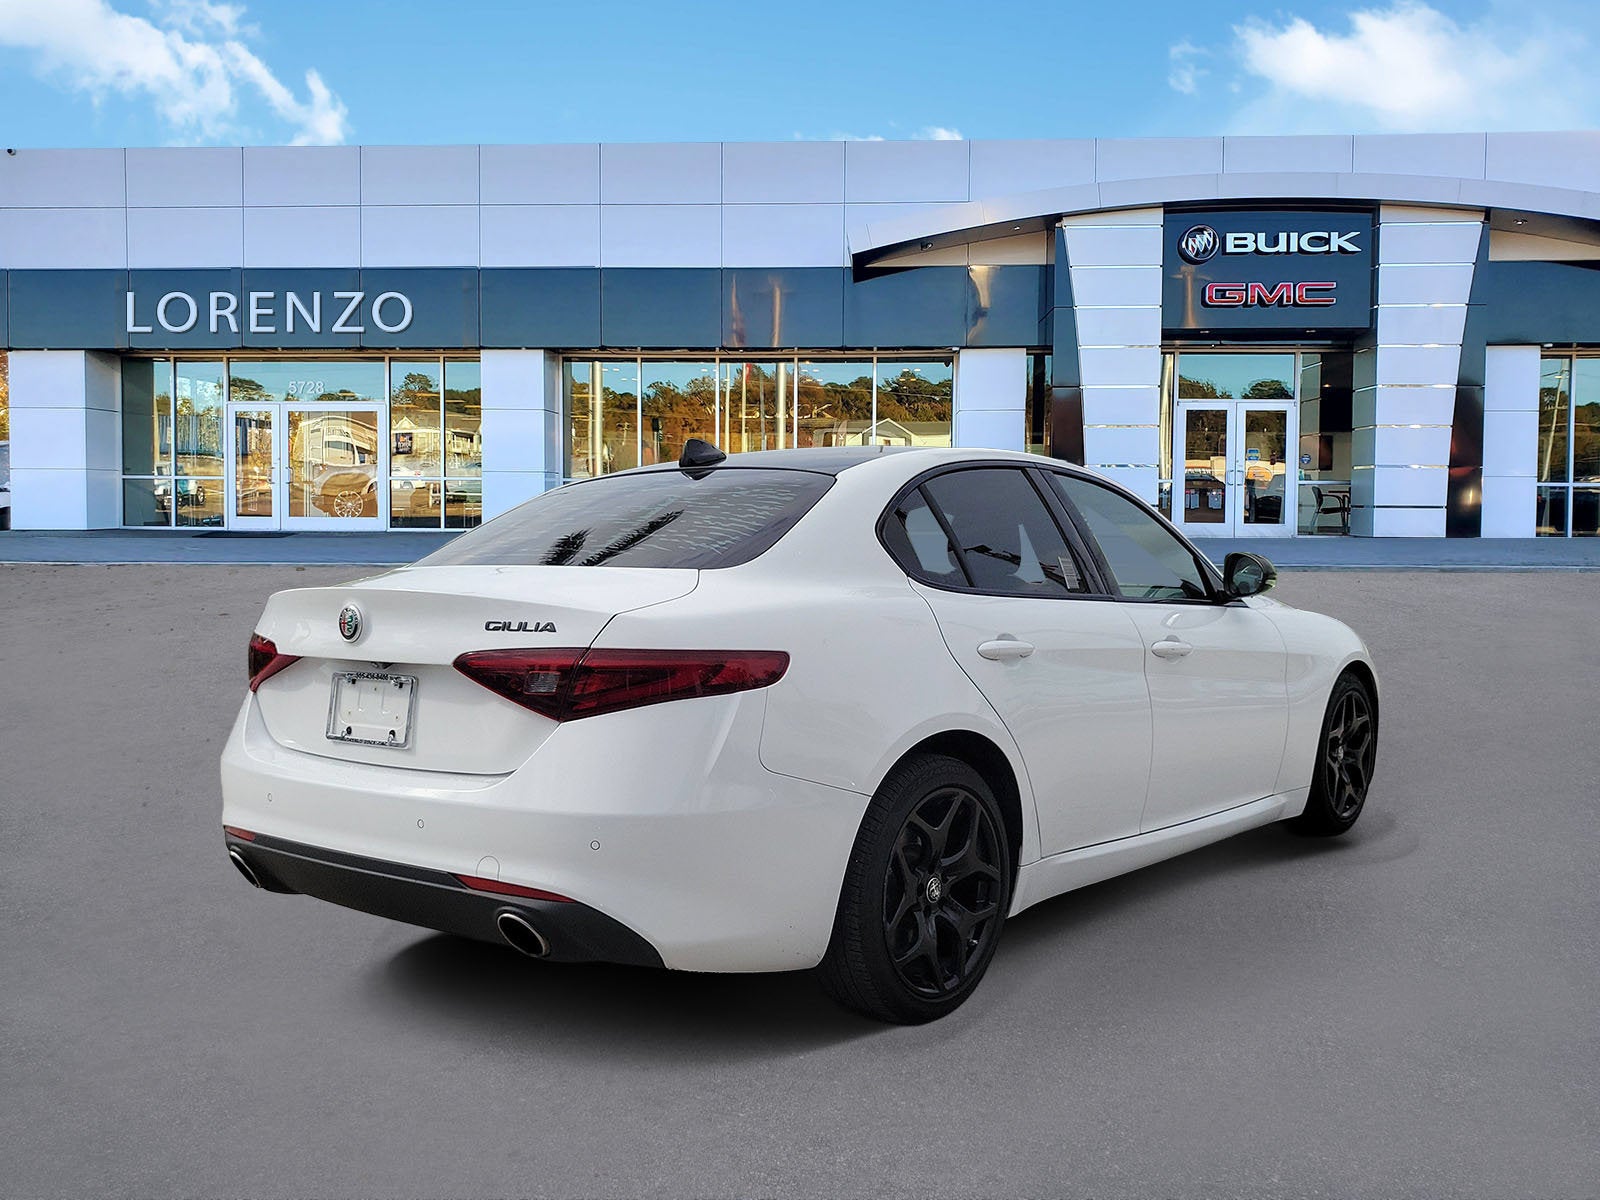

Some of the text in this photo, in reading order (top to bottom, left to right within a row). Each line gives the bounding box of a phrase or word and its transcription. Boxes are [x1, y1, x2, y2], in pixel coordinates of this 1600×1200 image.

[1225, 231, 1362, 253] BUICK
[1204, 281, 1337, 306] GMC
[126, 291, 413, 333] LORENZO
[288, 380, 325, 394] 5728
[484, 621, 558, 633] GIULIA
